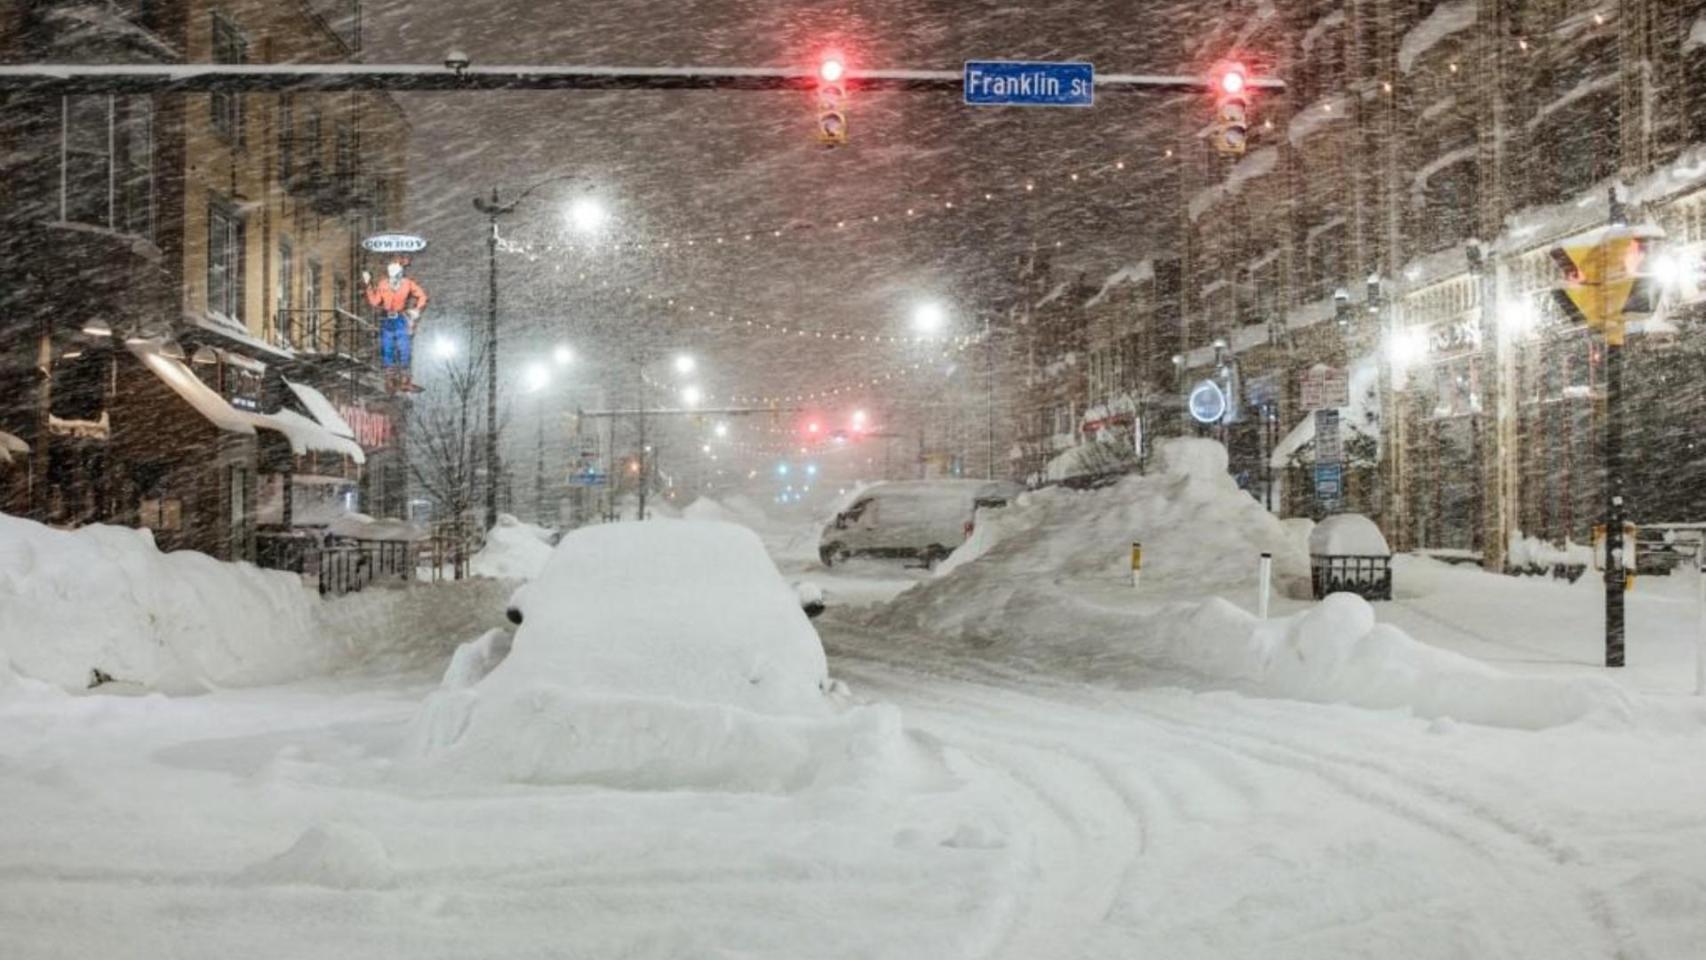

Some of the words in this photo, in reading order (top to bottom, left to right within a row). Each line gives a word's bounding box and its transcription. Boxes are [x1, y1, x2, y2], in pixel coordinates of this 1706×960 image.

[970, 70, 1059, 96] Franklin
[1071, 78, 1088, 96] St
[365, 239, 422, 249] COWBOY
